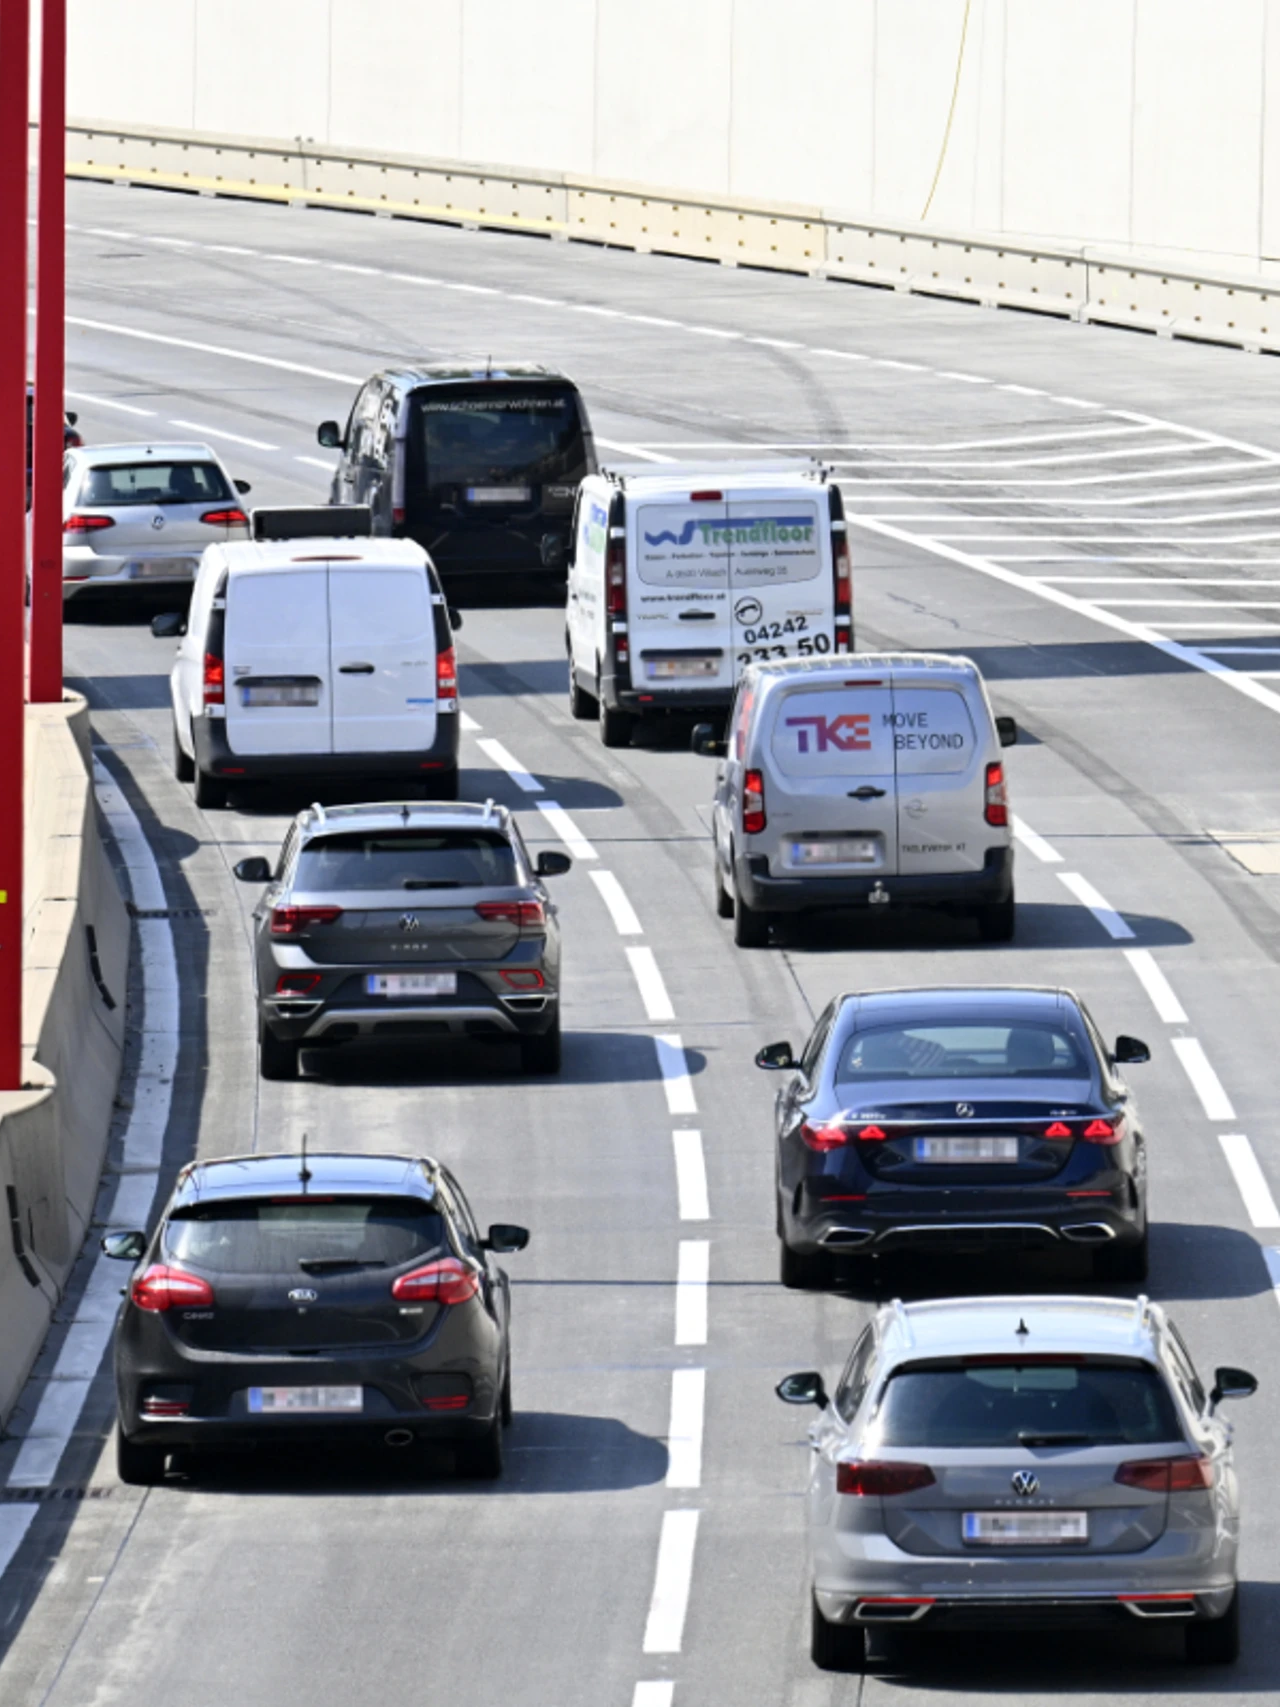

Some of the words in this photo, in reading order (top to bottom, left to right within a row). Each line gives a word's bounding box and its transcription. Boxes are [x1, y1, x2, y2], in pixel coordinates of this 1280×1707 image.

[699, 521, 814, 546] Trendfloor
[743, 616, 809, 644] 04242
[797, 632, 831, 656] 50
[785, 714, 872, 753] TKE
[882, 712, 928, 729] MOVE
[895, 734, 964, 750] BEYOND
